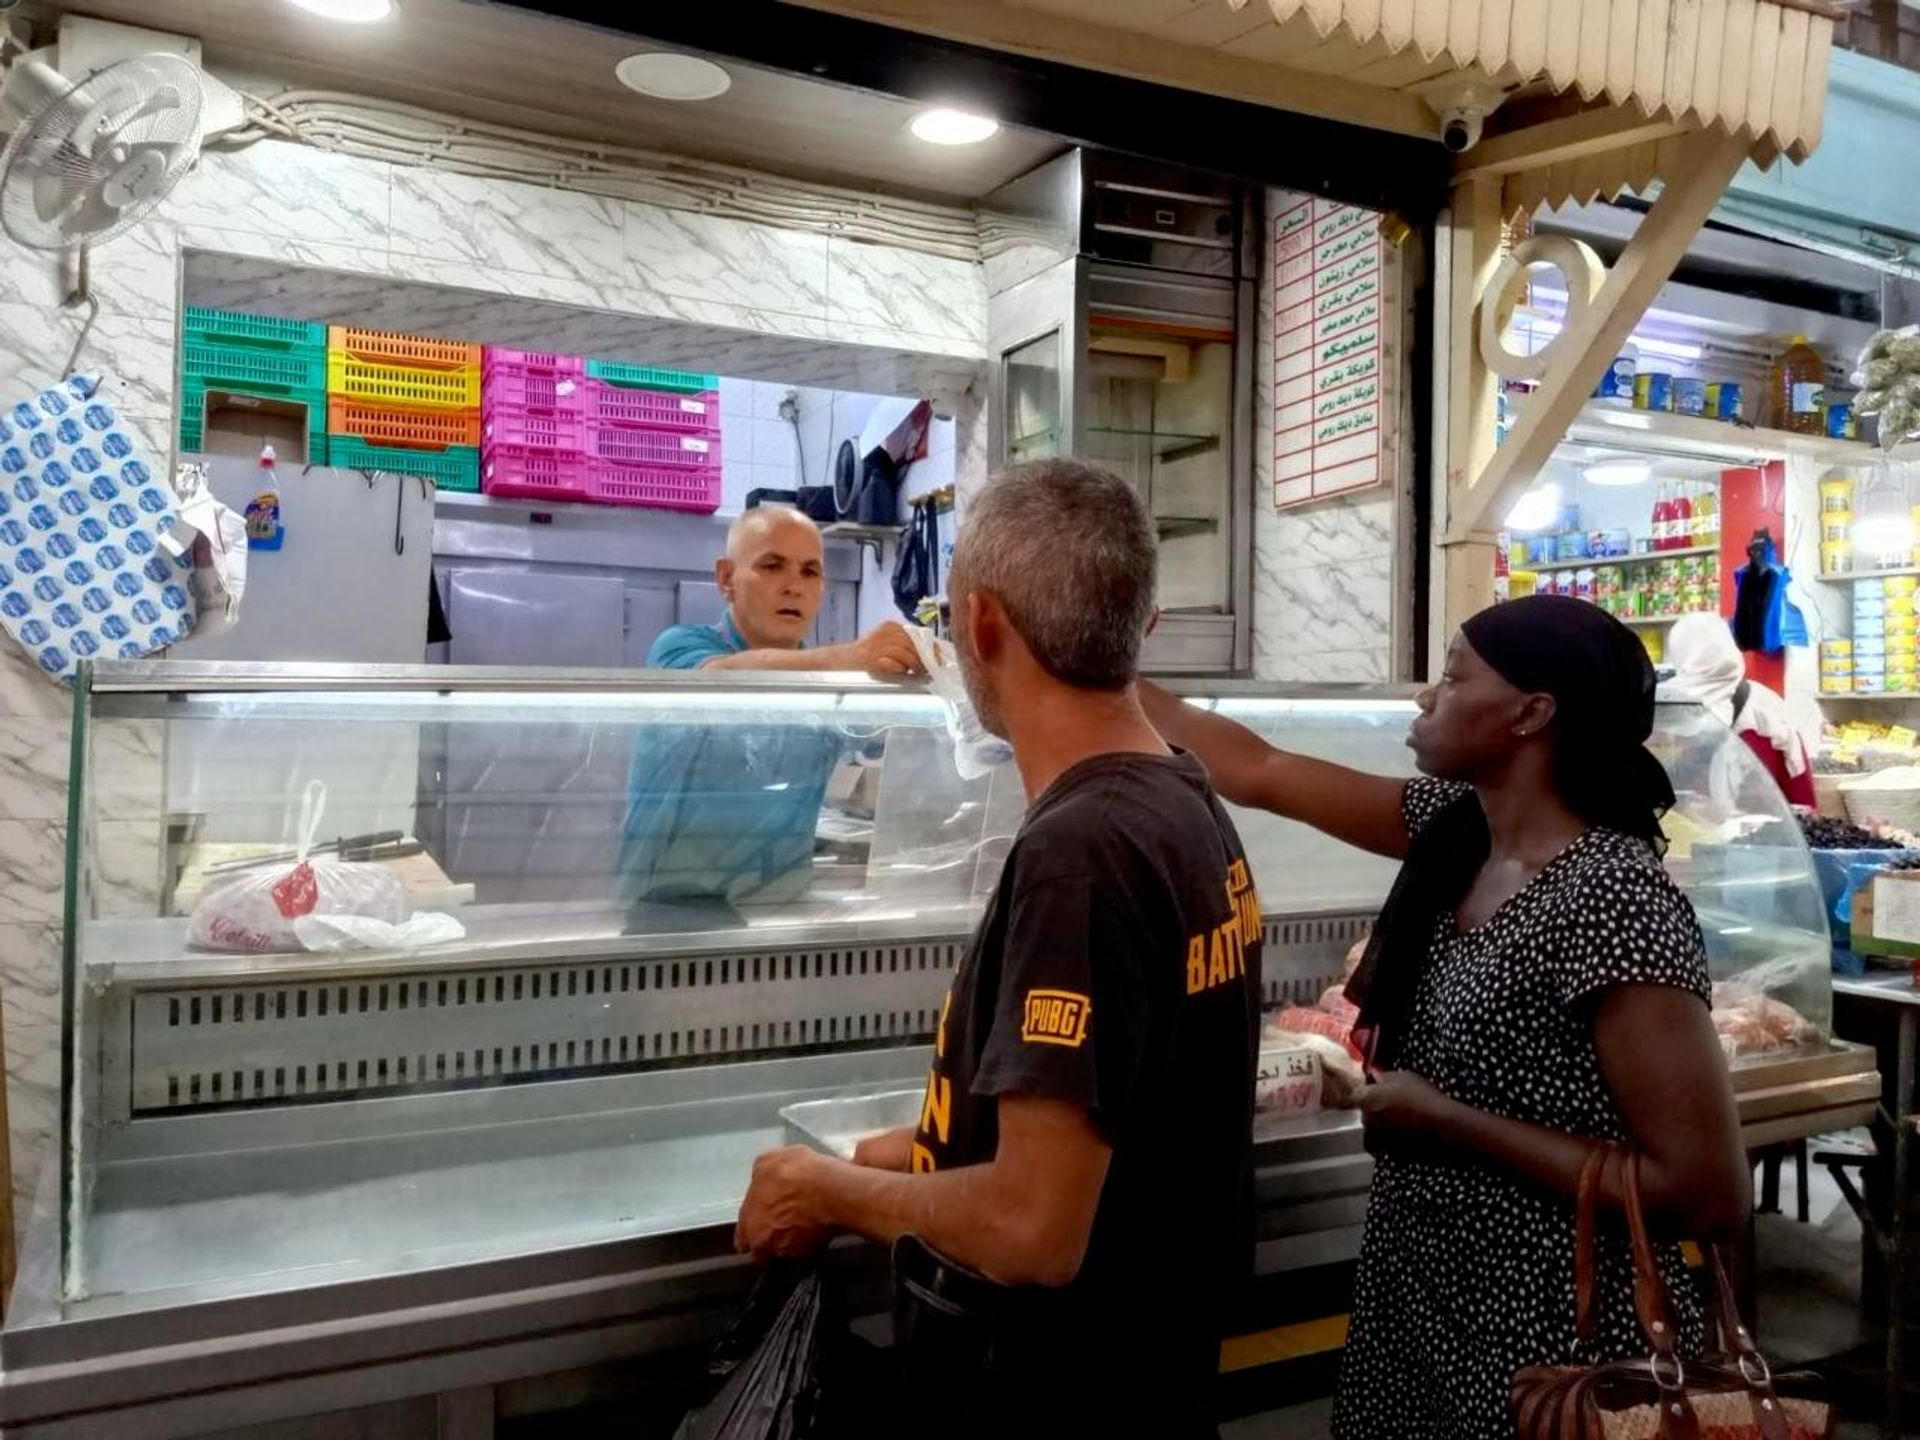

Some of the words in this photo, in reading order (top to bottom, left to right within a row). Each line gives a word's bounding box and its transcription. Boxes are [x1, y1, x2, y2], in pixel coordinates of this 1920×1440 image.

[1347, 256, 1375, 277] سلامي
[1346, 282, 1375, 302] سلامي
[1029, 998, 1079, 1036] PUBG
